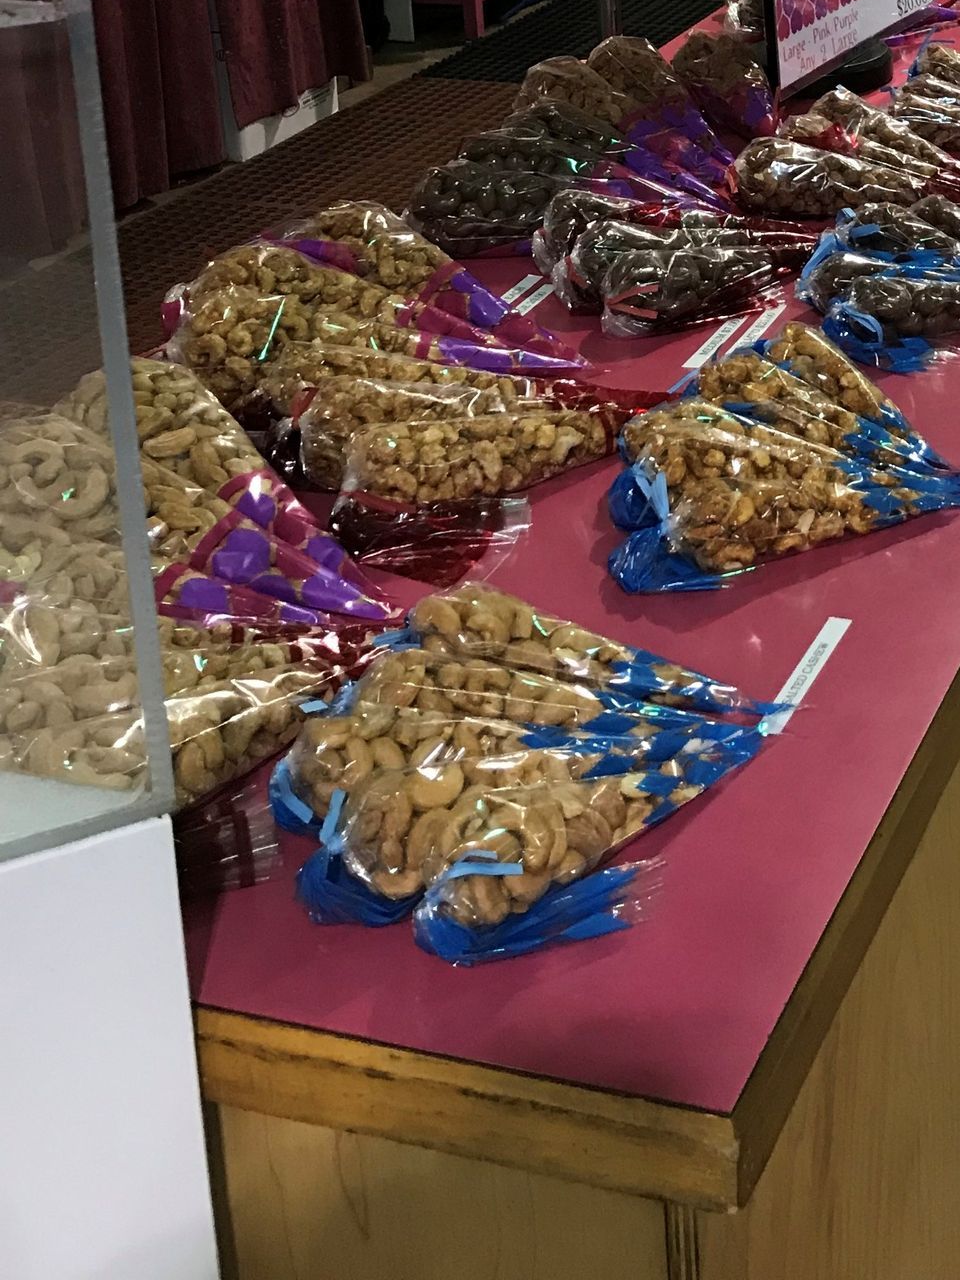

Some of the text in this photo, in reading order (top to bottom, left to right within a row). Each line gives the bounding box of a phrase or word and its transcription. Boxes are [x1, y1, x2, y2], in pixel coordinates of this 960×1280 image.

[782, 42, 806, 63] Large
[812, 25, 829, 45] Pink
[834, 8, 860, 37] Purple
[800, 55, 816, 73] Any
[819, 45, 828, 62] 2
[831, 28, 858, 56] Large
[782, 675, 808, 705] SALTED
